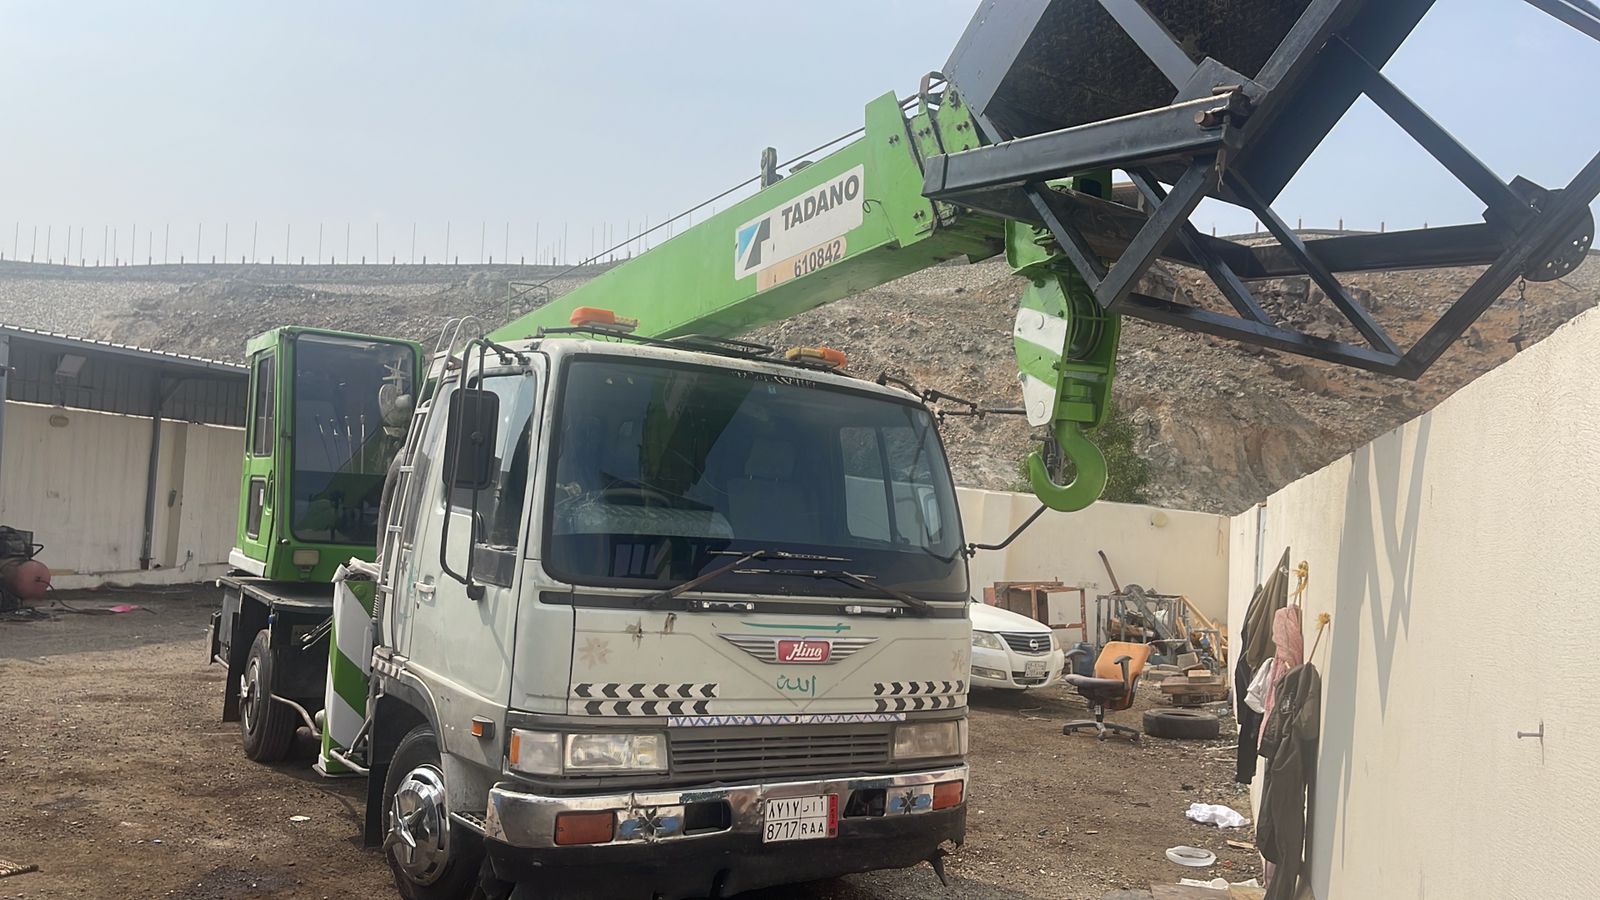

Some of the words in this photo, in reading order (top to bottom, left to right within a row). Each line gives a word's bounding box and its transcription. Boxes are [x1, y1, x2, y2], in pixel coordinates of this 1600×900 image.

[782, 175, 860, 231] TADANO
[794, 239, 841, 277] 610842
[786, 641, 823, 661] Hino
[766, 821, 798, 840] 8717
[801, 822, 824, 835] RAA
